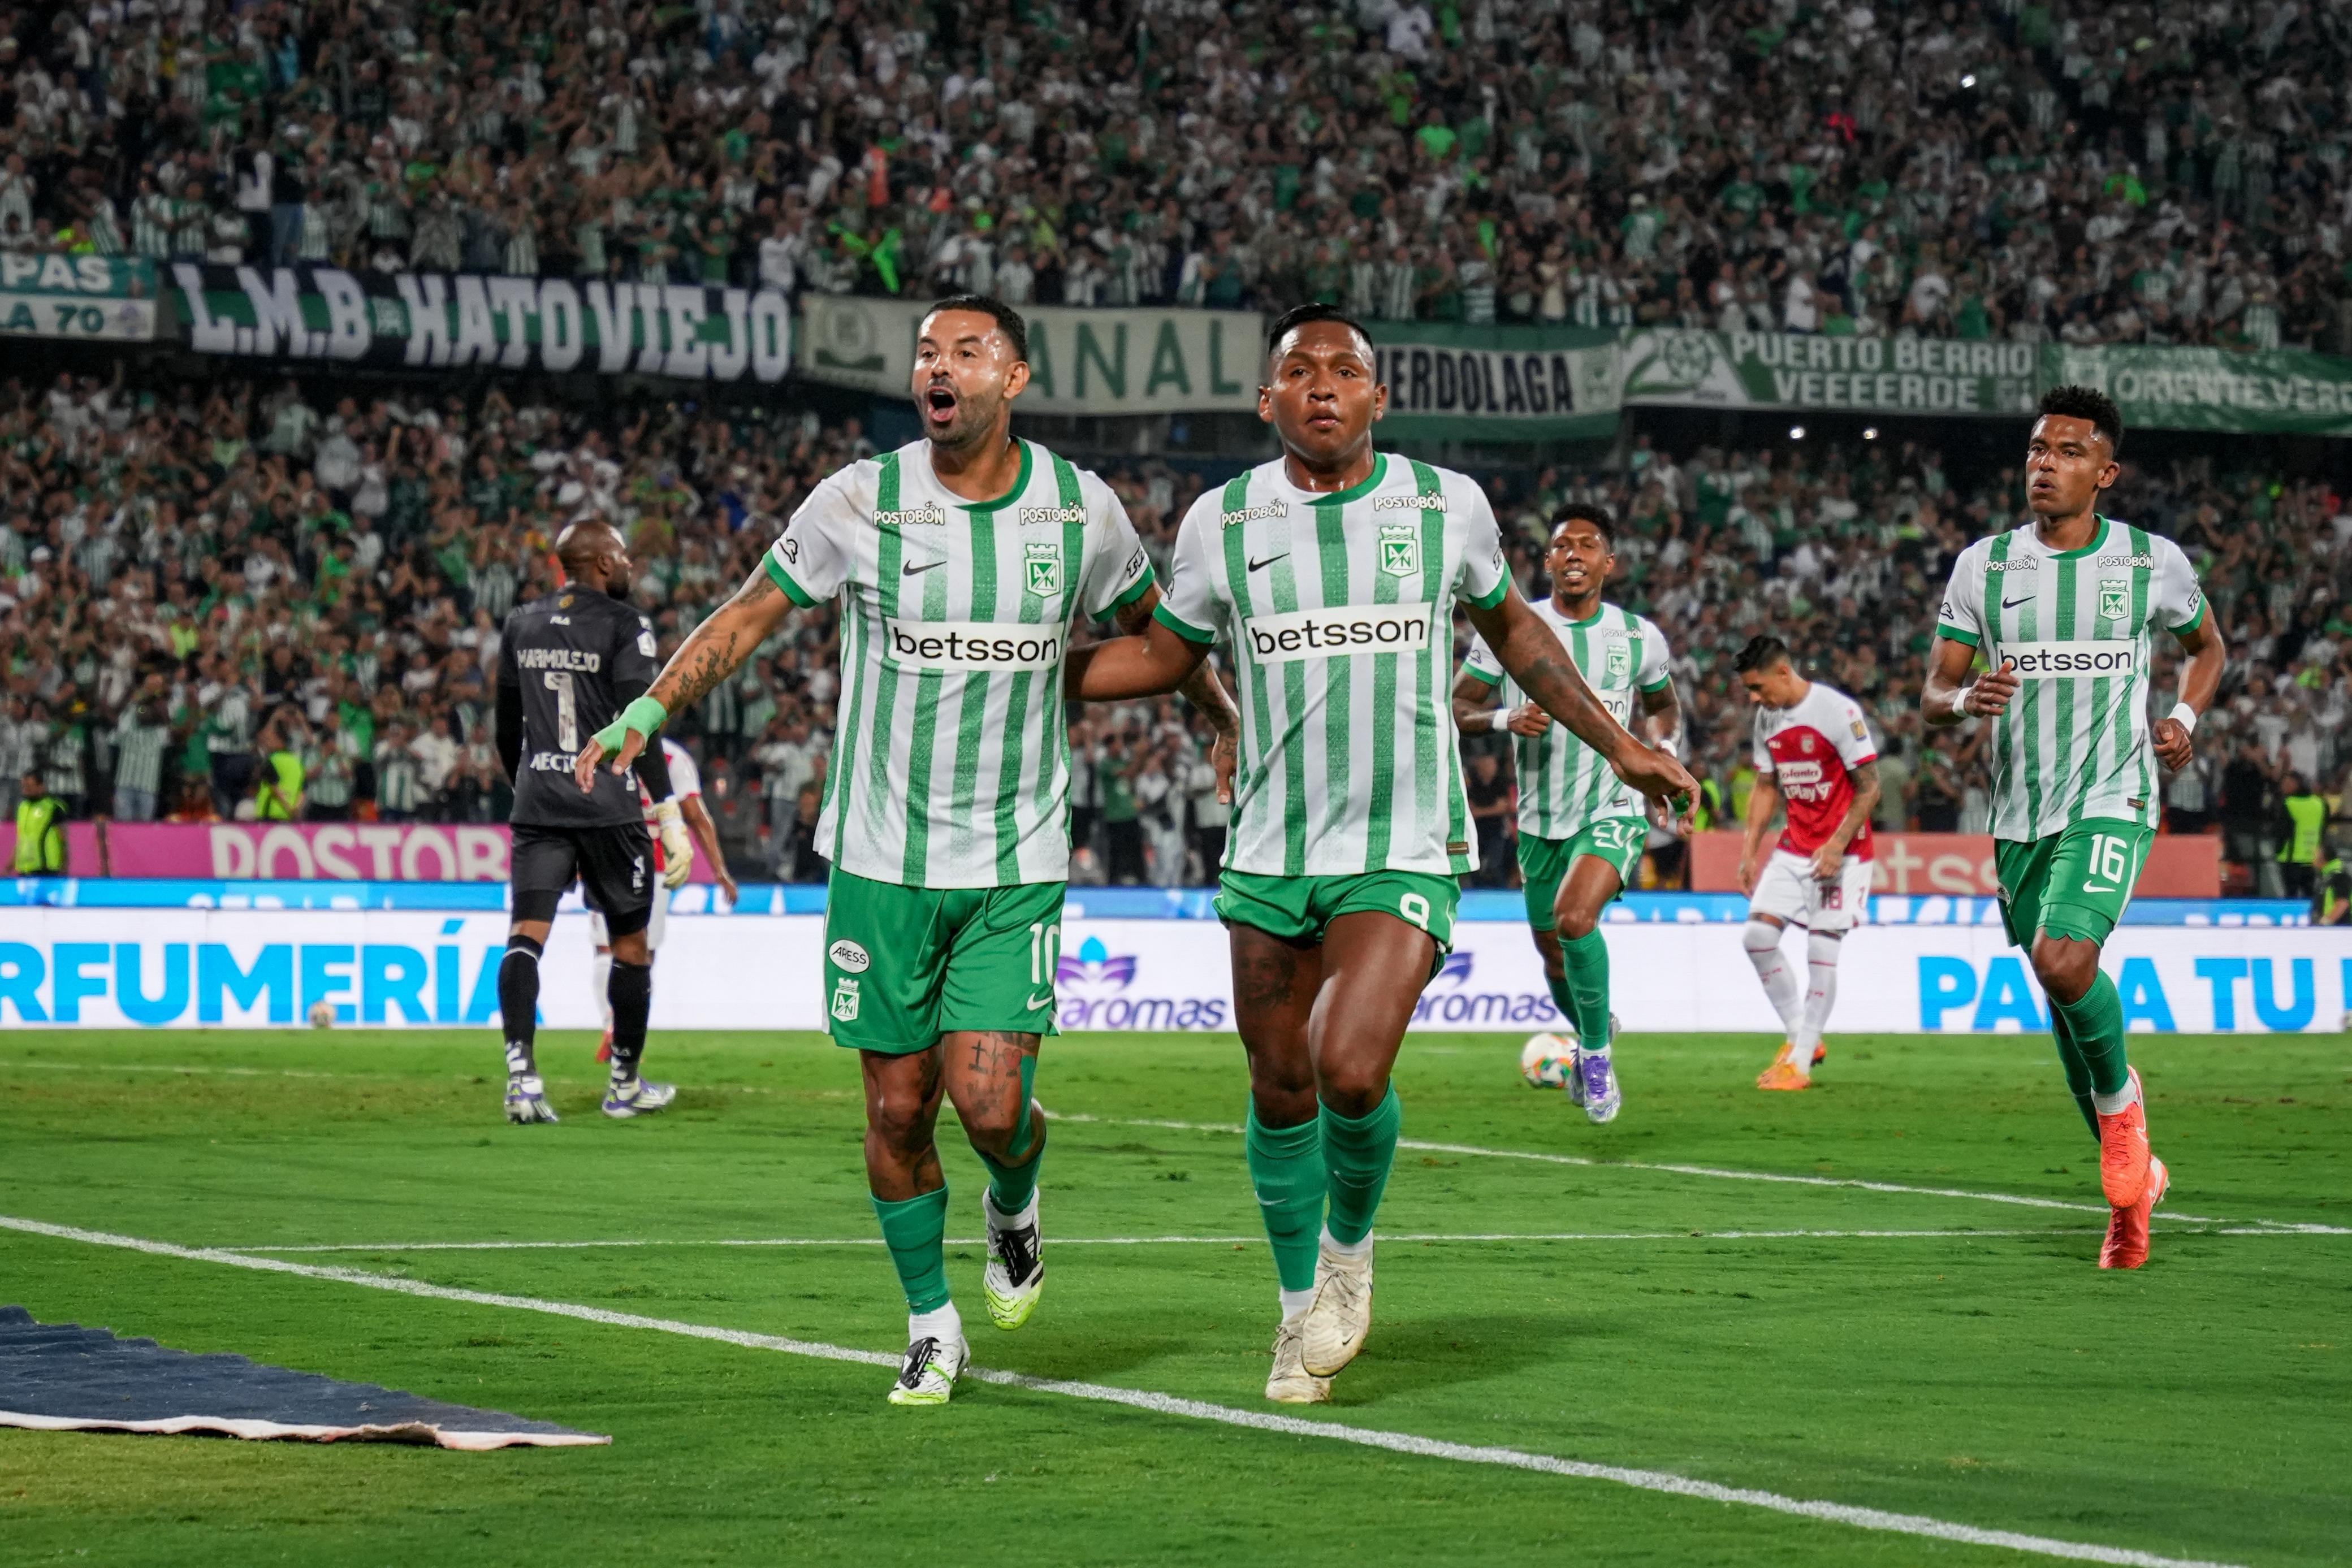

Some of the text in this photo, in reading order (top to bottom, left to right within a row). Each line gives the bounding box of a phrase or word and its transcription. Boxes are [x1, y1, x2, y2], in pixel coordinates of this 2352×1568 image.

[54, 303, 105, 333] 70
[1730, 330, 2033, 378] PUERTO BERRIO
[893, 627, 1057, 662] betsson
[1251, 619, 1425, 655] betsson
[544, 672, 578, 752] 1
[2089, 834, 2128, 884] 16
[1399, 893, 1430, 932] 9
[1818, 886, 1843, 910] 18
[832, 946, 867, 964] ARESS
[1918, 957, 2176, 1032] PAA
[2194, 958, 2315, 1032] TU
